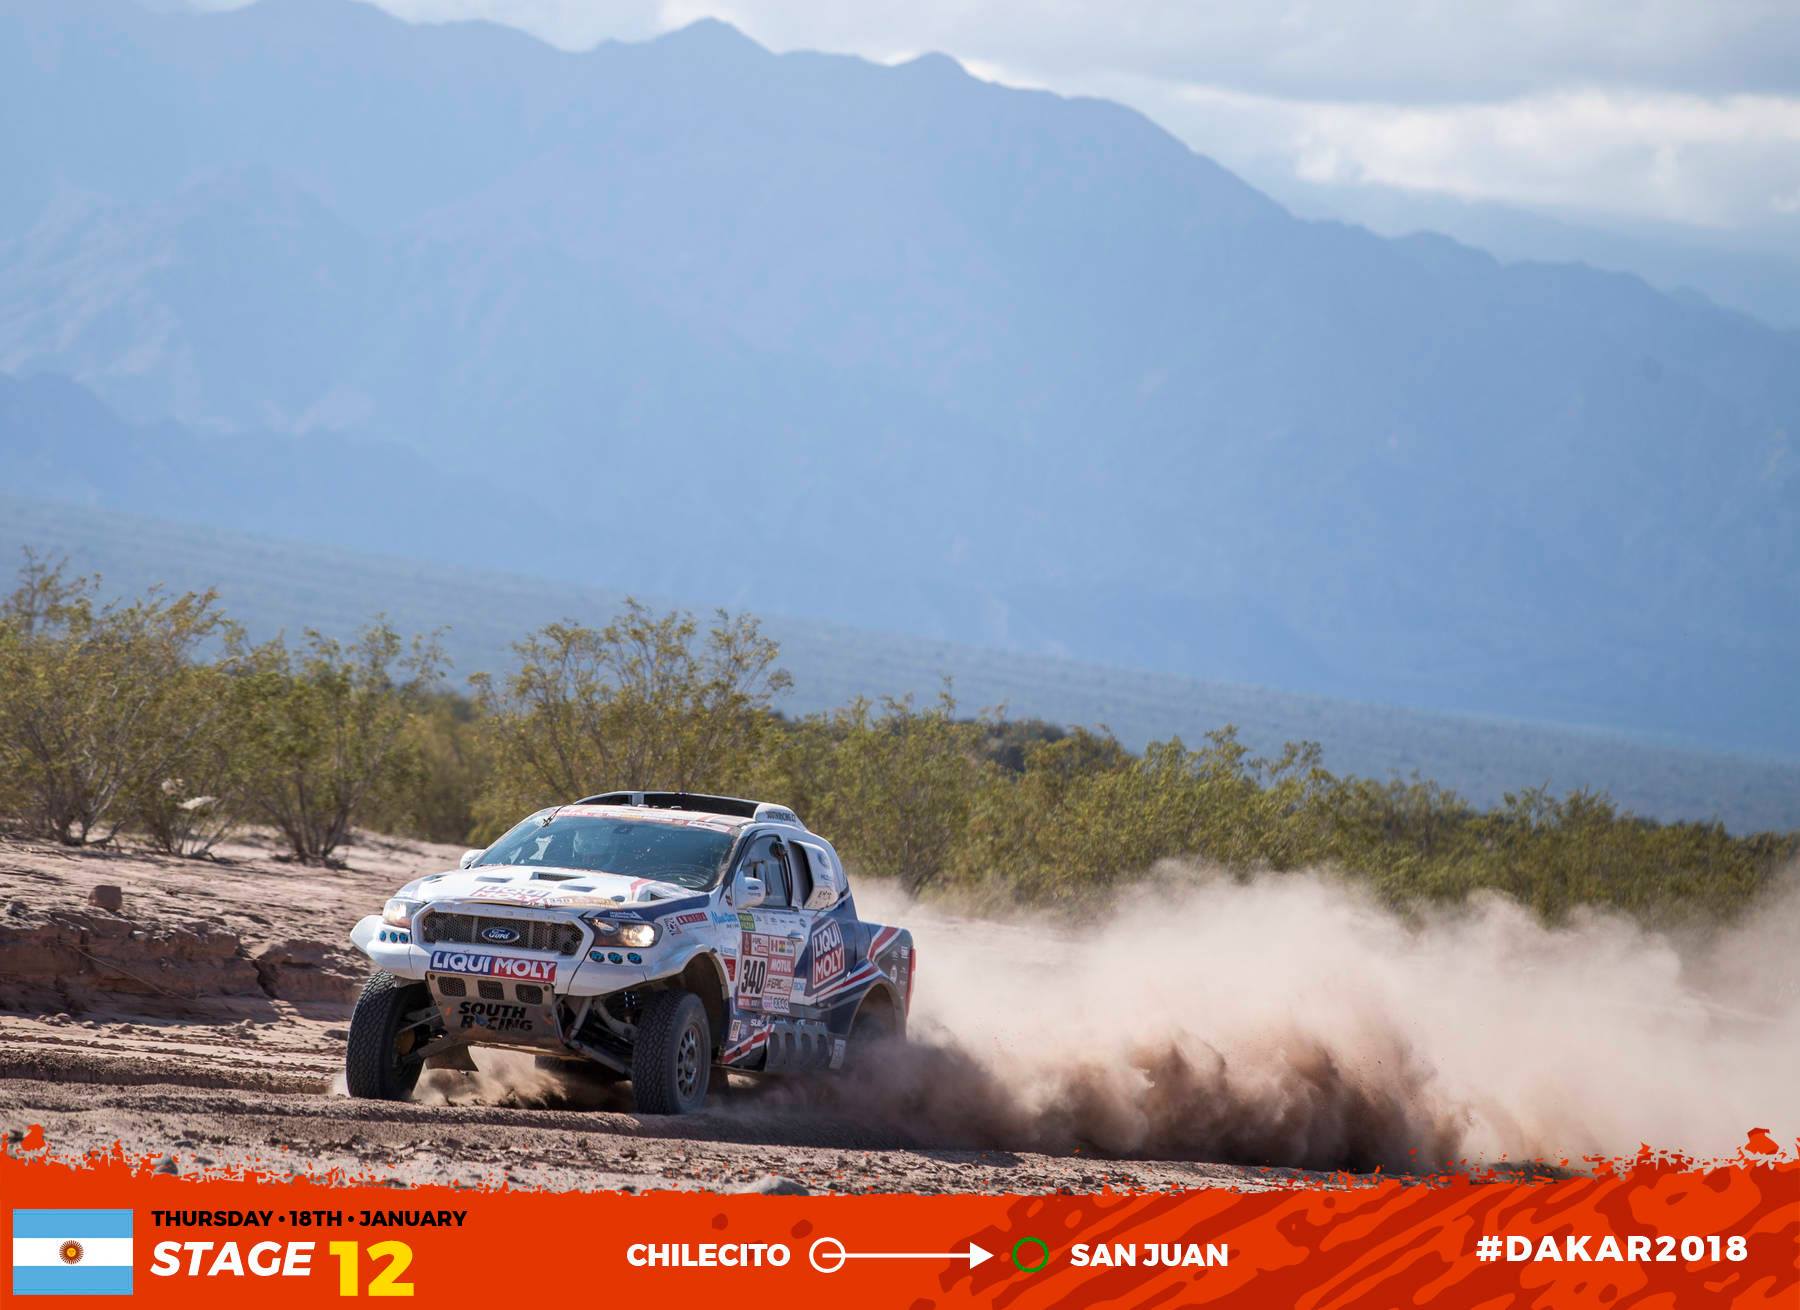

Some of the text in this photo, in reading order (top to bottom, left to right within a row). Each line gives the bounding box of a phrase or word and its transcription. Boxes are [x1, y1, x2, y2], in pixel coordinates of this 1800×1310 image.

[488, 929, 511, 940] Ford
[814, 923, 841, 958] LIQUI
[433, 951, 557, 979] LIQUI MOLY
[769, 959, 792, 974] MOTUL
[815, 947, 843, 982] MOLY
[741, 959, 767, 995] 340
[459, 1001, 527, 1020] SOUTH
[461, 1014, 533, 1031] RCING
